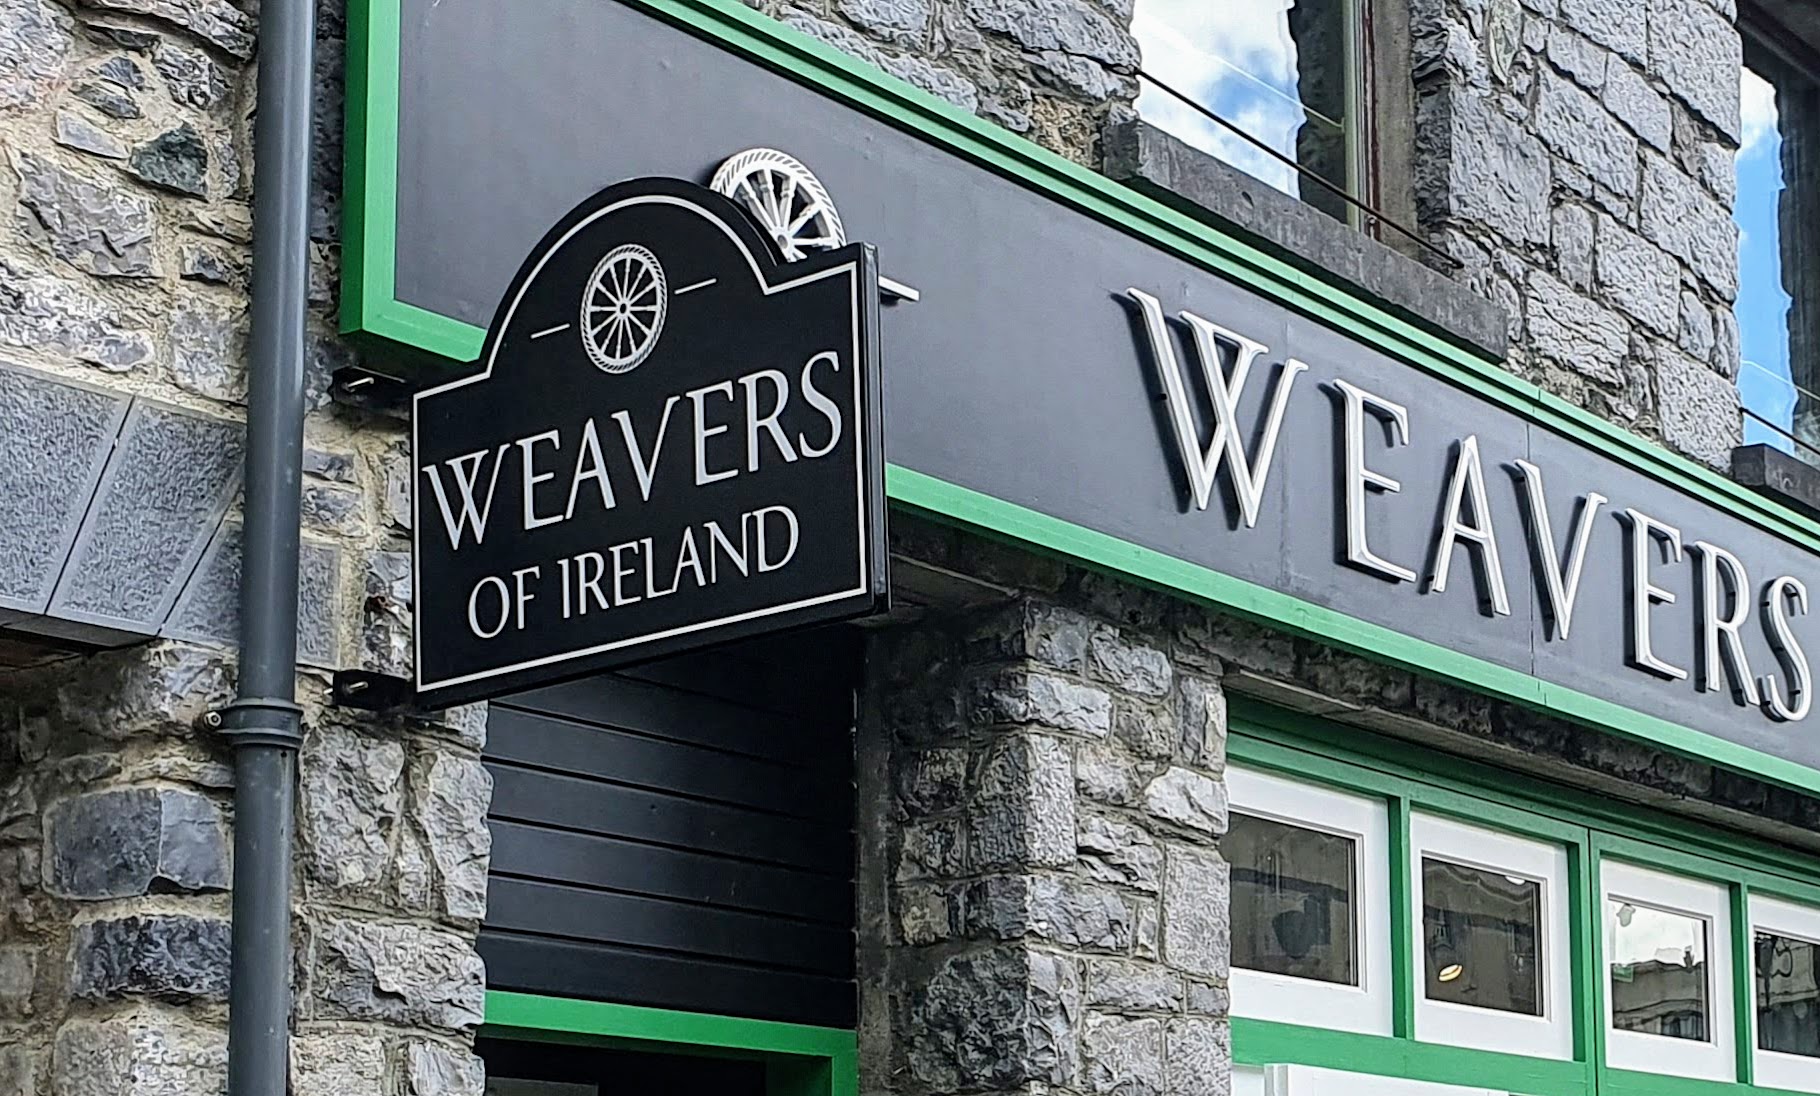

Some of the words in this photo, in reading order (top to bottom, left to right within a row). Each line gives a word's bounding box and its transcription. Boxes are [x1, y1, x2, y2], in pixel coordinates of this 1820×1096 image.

[422, 350, 844, 551] WEAVERS
[1127, 286, 1812, 723] WEAVERS
[468, 565, 541, 640] OF
[557, 504, 800, 620] IRELAND
